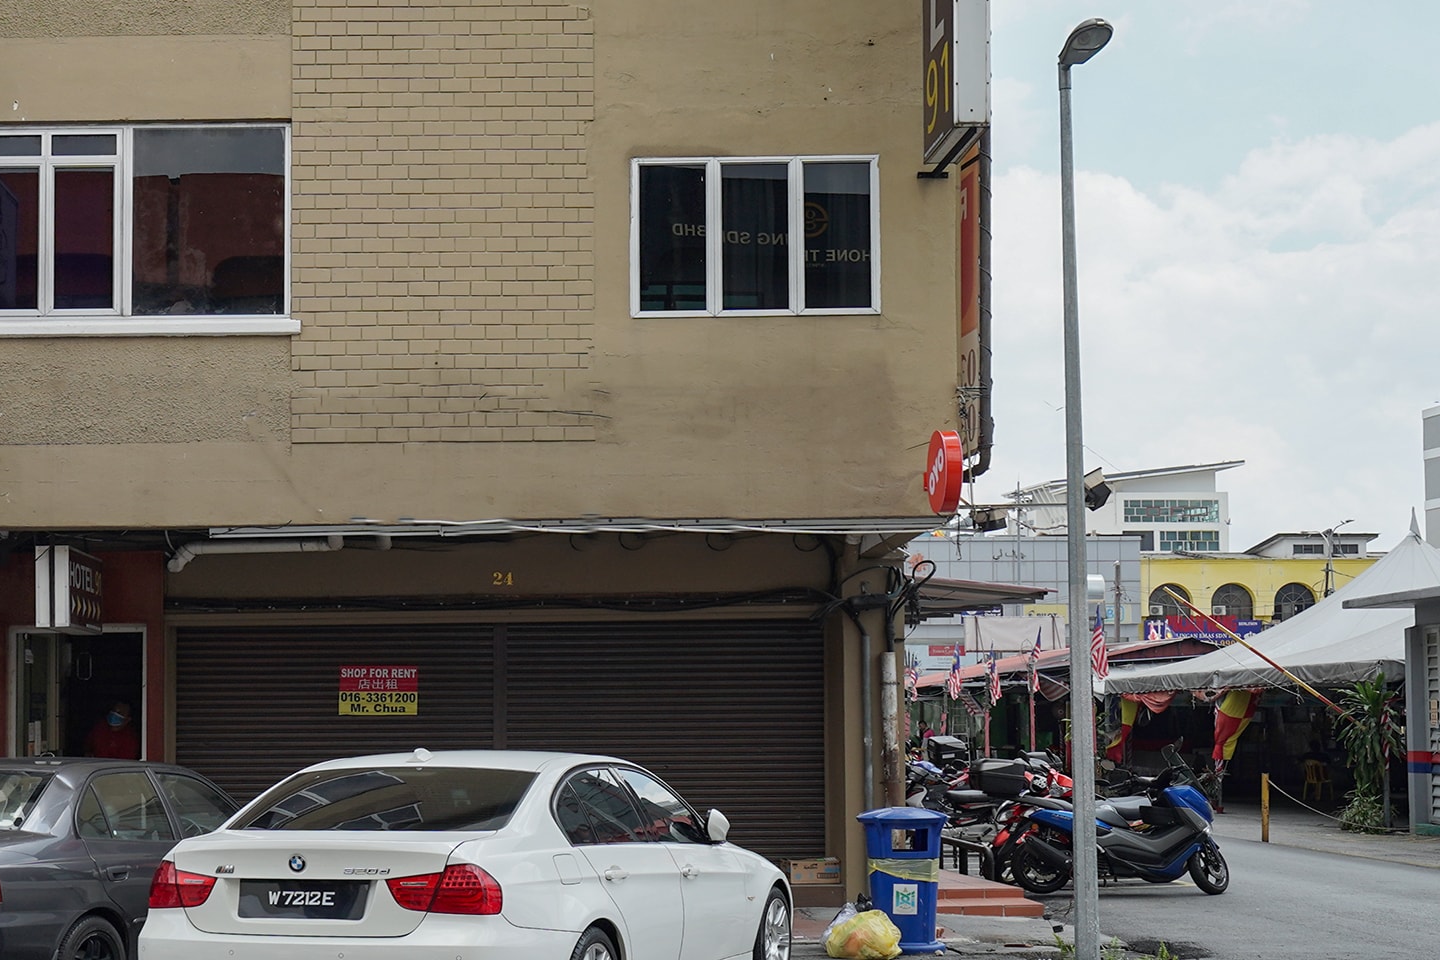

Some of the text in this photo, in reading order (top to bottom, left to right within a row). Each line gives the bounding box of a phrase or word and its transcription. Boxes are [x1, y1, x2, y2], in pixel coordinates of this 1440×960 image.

[926, 41, 949, 134] 91
[929, 447, 944, 496] OYO
[69, 560, 95, 594] HOTEL
[492, 571, 513, 586] 24
[341, 668, 417, 678] SHOP FOR RENT
[358, 678, 398, 690] 店出租
[340, 692, 416, 703] 016-3361200
[350, 703, 406, 713] Mr. Chua
[268, 890, 336, 906] W 7212E
